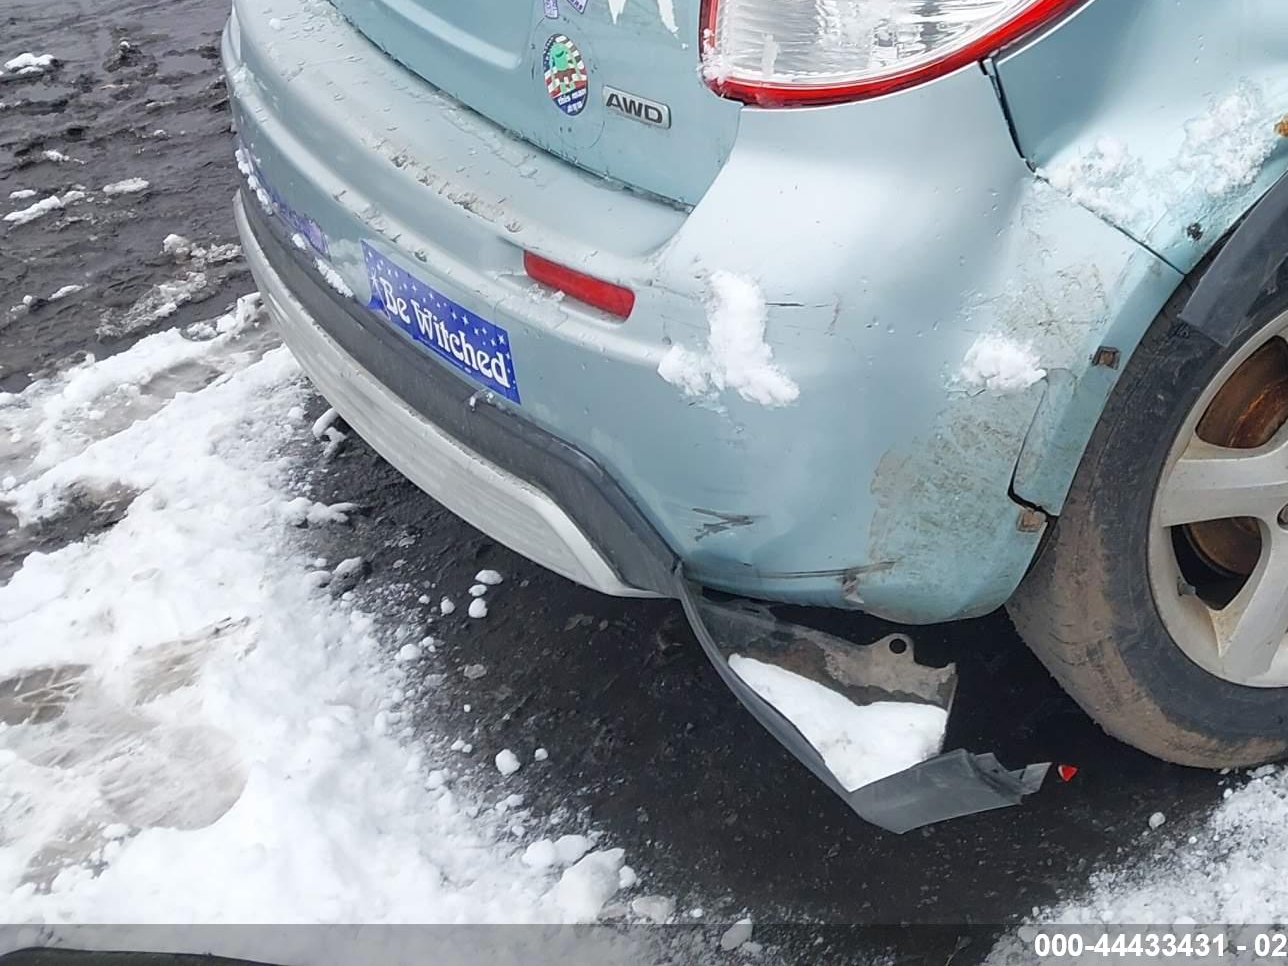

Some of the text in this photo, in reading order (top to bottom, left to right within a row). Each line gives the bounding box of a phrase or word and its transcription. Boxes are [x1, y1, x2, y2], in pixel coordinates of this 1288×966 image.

[606, 93, 663, 124] AWD
[379, 276, 510, 388] Be Witched
